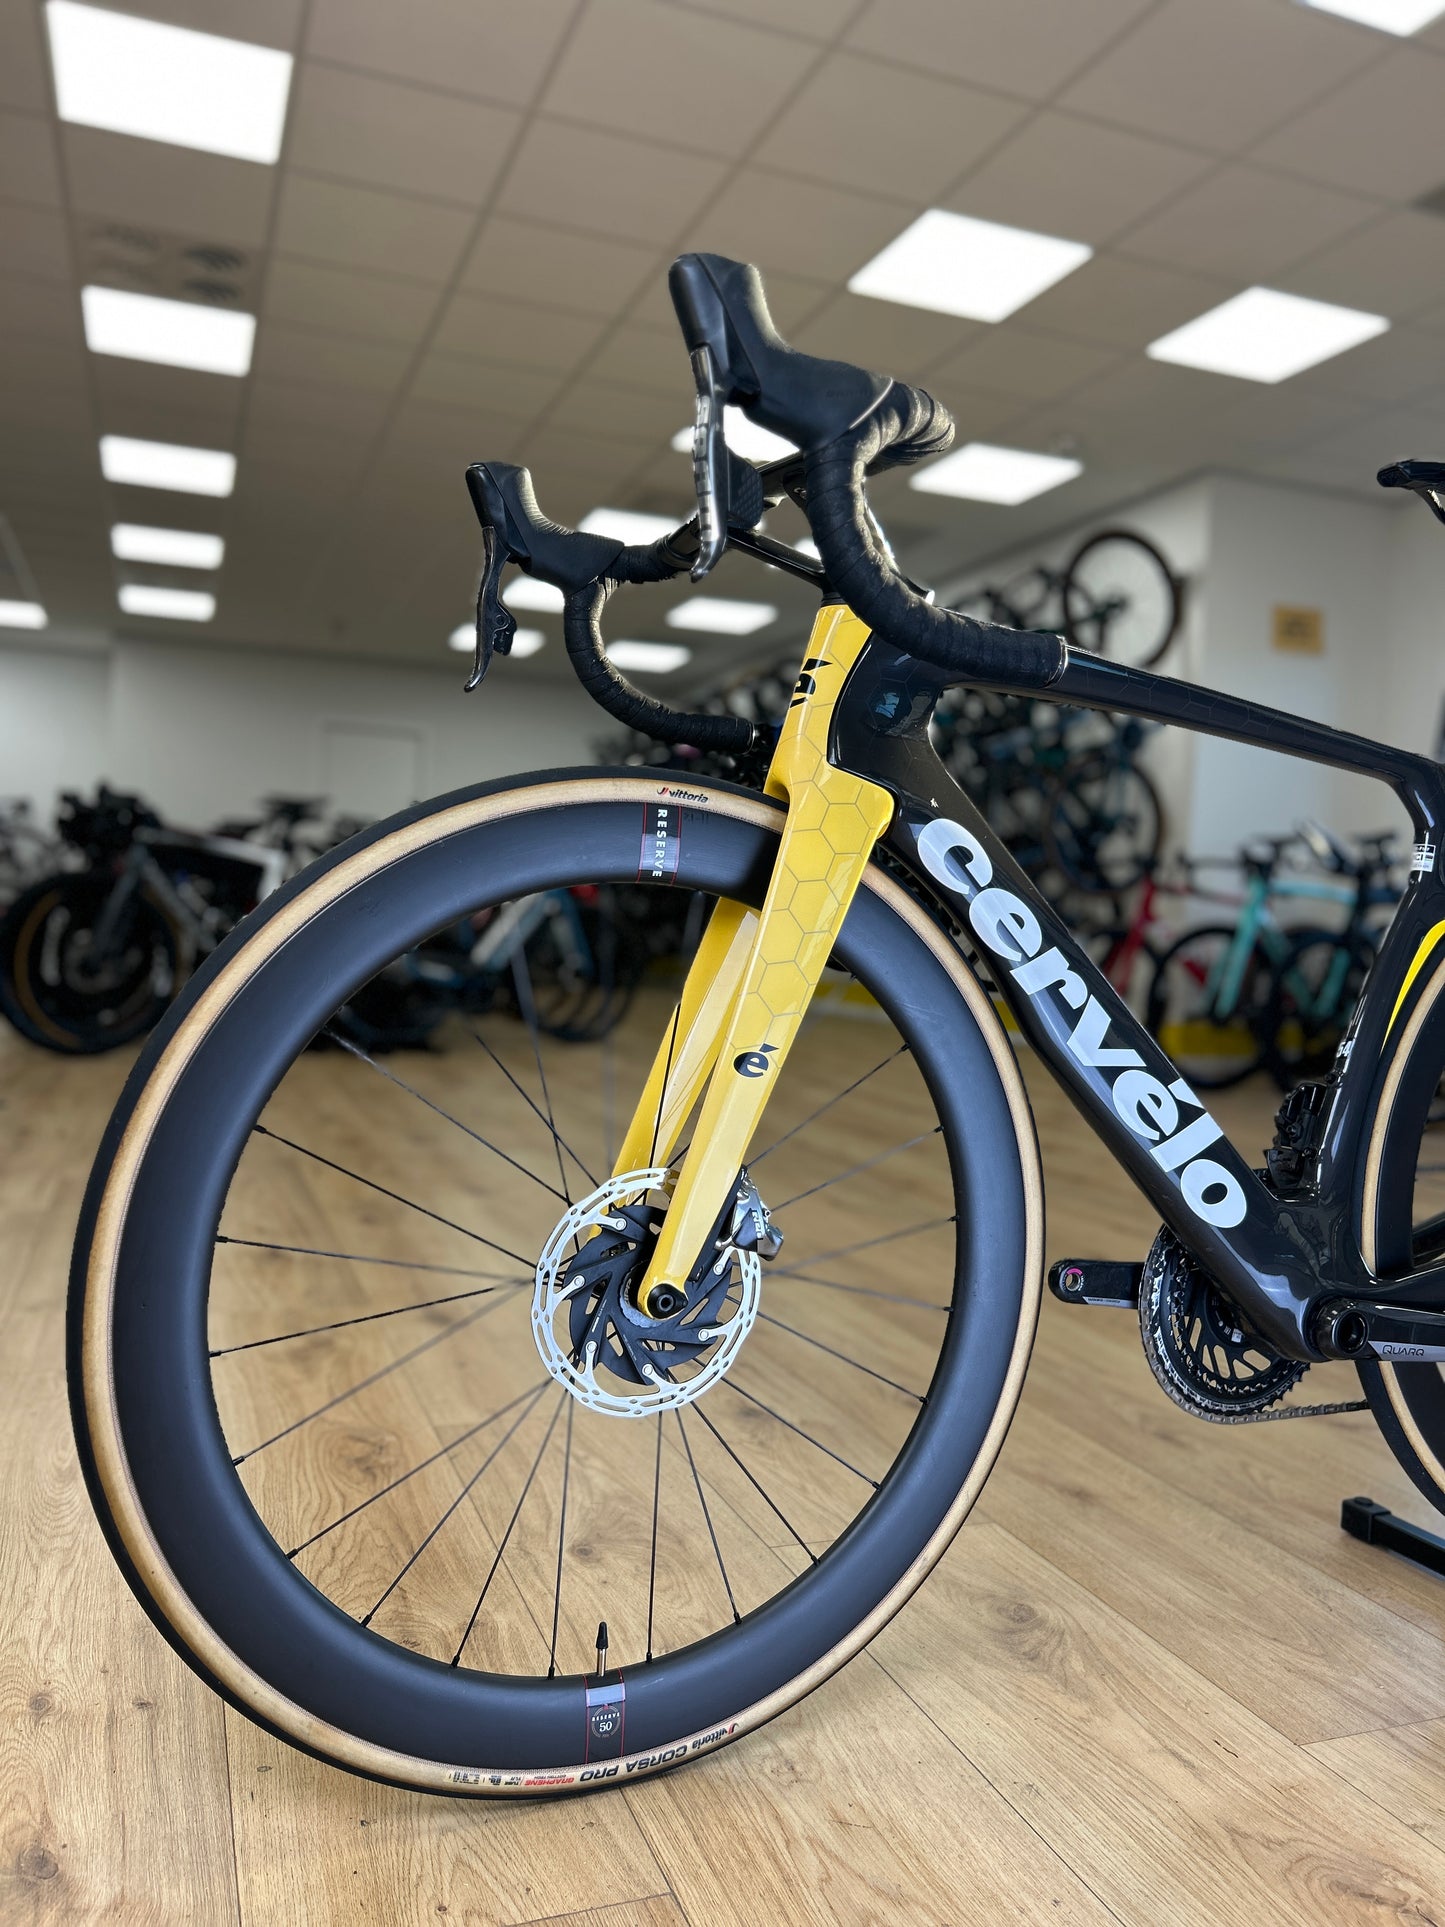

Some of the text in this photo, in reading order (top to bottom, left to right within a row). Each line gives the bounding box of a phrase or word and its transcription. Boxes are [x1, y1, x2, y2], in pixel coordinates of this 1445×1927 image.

[668, 789, 709, 804] vittoria
[652, 809, 668, 877] RESERVE
[917, 818, 1247, 1229] cervélo
[733, 1043, 780, 1078] é
[1382, 1344, 1425, 1357] QUARQ
[591, 1712, 621, 1722] RESERVE
[599, 1721, 613, 1732] 50
[524, 1727, 728, 1786] vittoria CORSA PRO GRAPHENE
